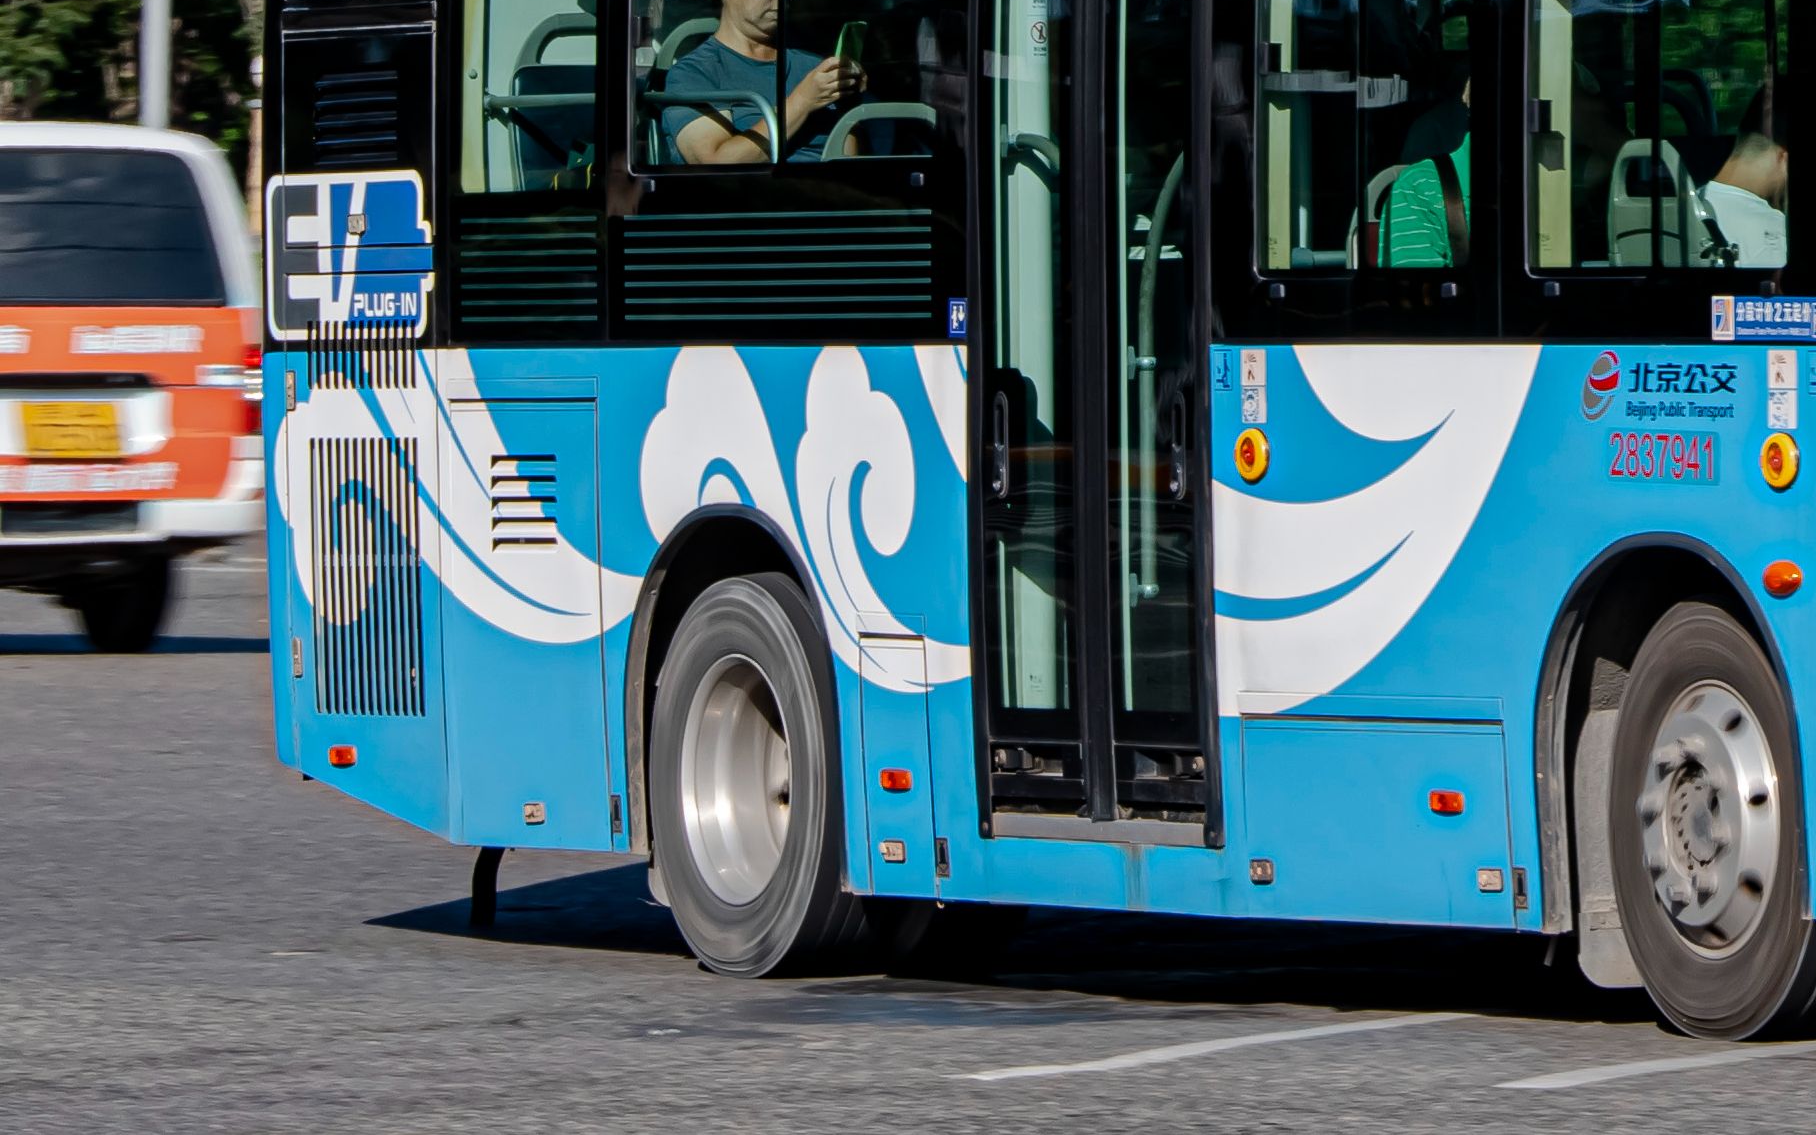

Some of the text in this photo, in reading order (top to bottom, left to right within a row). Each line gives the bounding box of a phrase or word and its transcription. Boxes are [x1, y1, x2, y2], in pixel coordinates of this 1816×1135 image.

[353, 292, 418, 318] PLUG-IN
[1628, 363, 1739, 394] 北京公交
[1625, 400, 1735, 421] Beijing Public Transport
[1608, 432, 1715, 480] 2837941
